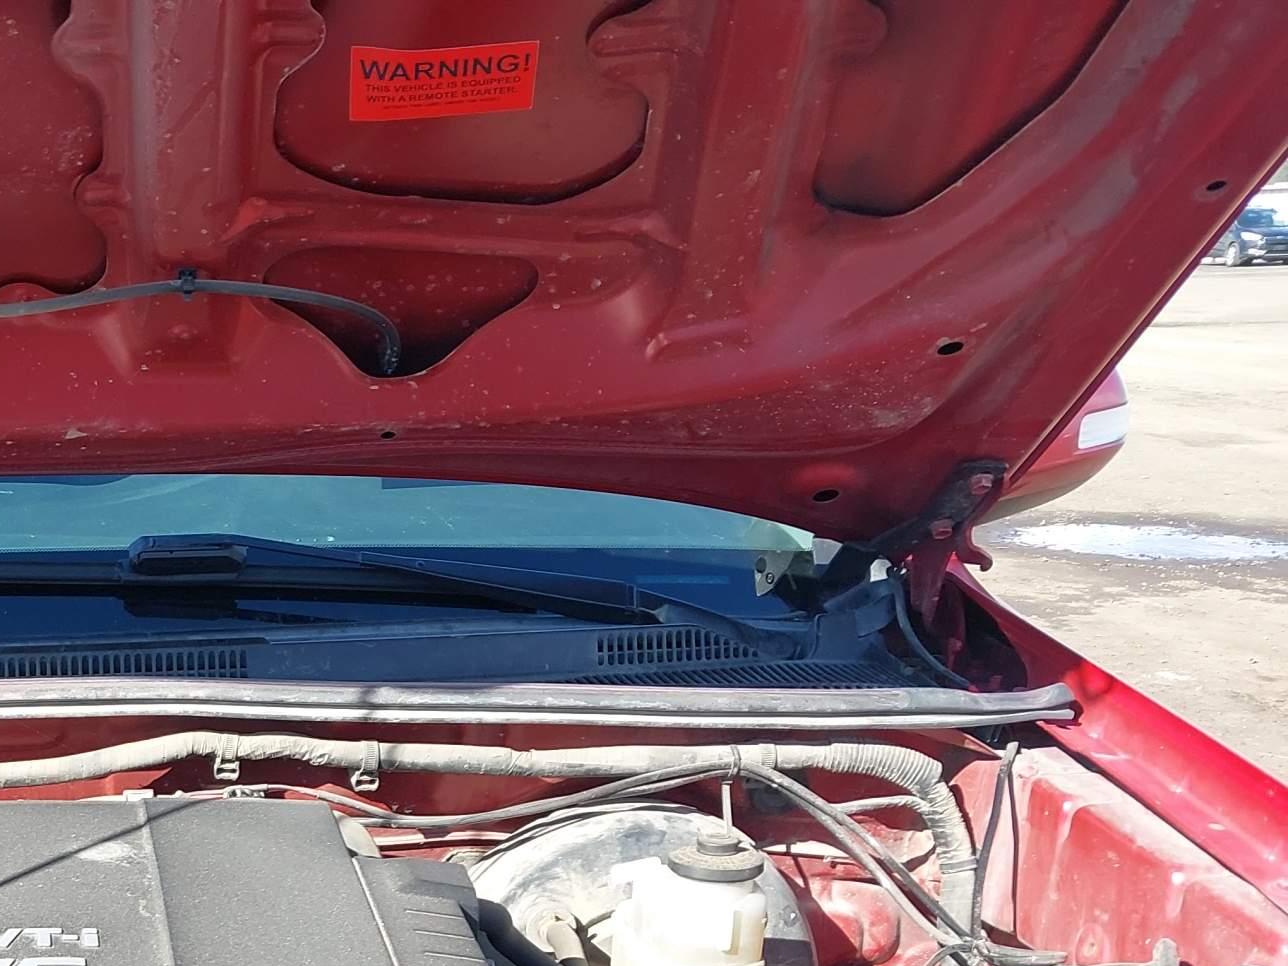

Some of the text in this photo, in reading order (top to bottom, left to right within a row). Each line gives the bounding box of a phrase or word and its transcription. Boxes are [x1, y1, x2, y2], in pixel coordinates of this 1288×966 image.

[359, 53, 532, 81] WARNING!
[365, 76, 521, 93] THIS VEHICLE IS EQUIPPED
[366, 95, 396, 103] WITH
[398, 94, 407, 103] A
[409, 90, 458, 102] REMOTE
